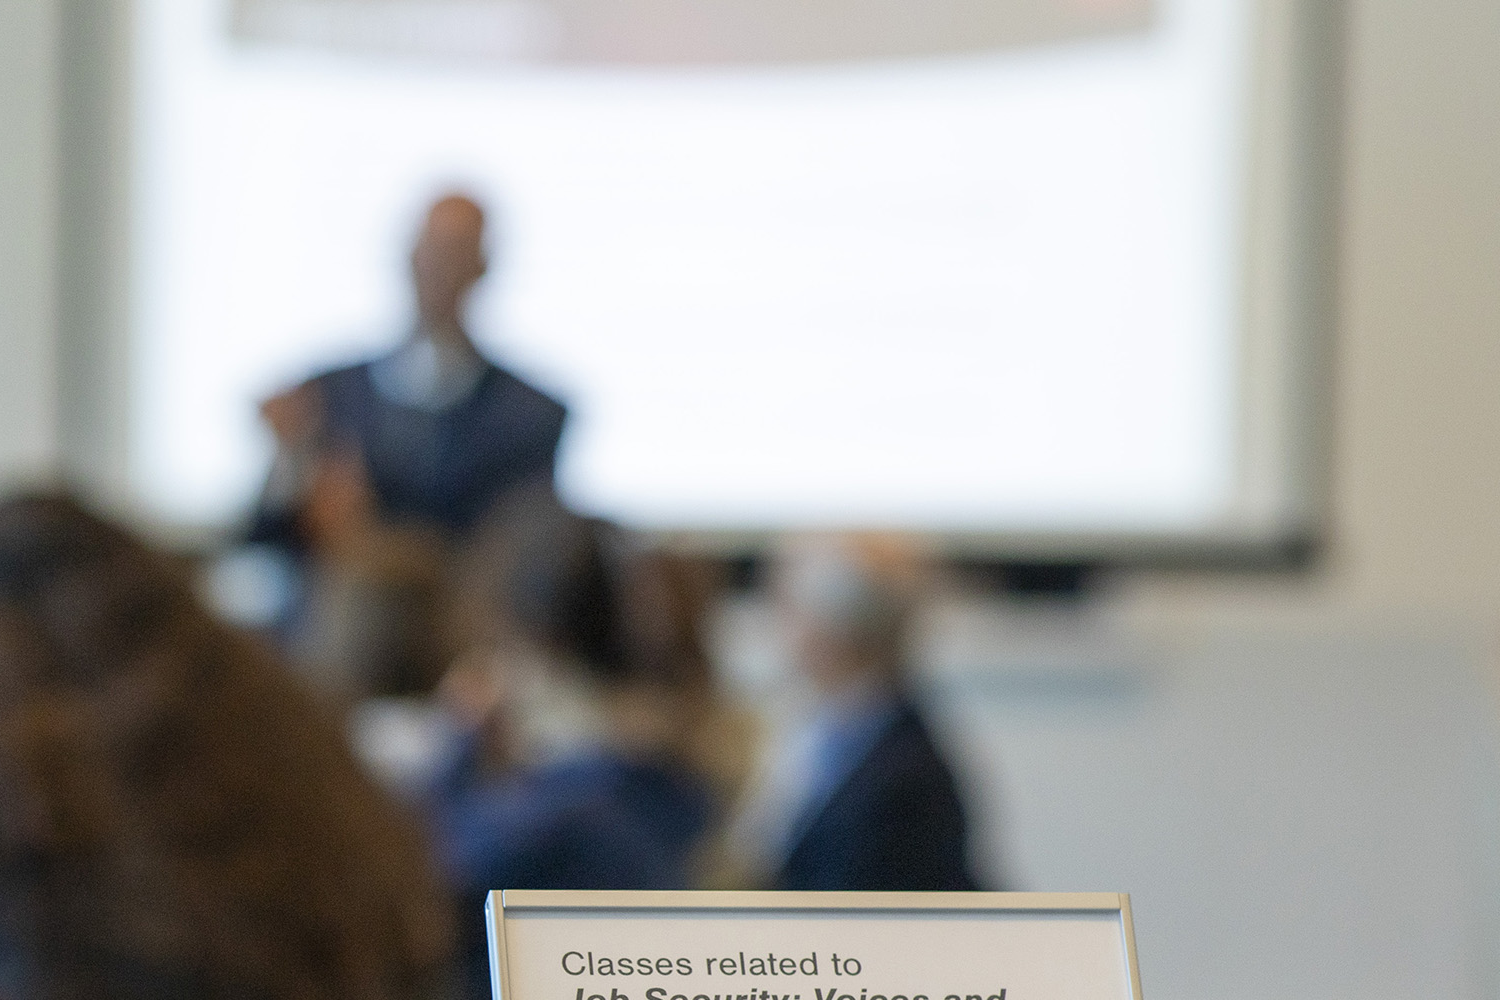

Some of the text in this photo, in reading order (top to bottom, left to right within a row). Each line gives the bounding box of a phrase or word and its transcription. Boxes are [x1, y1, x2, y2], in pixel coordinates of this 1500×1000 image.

[561, 950, 862, 977] Classes related to
